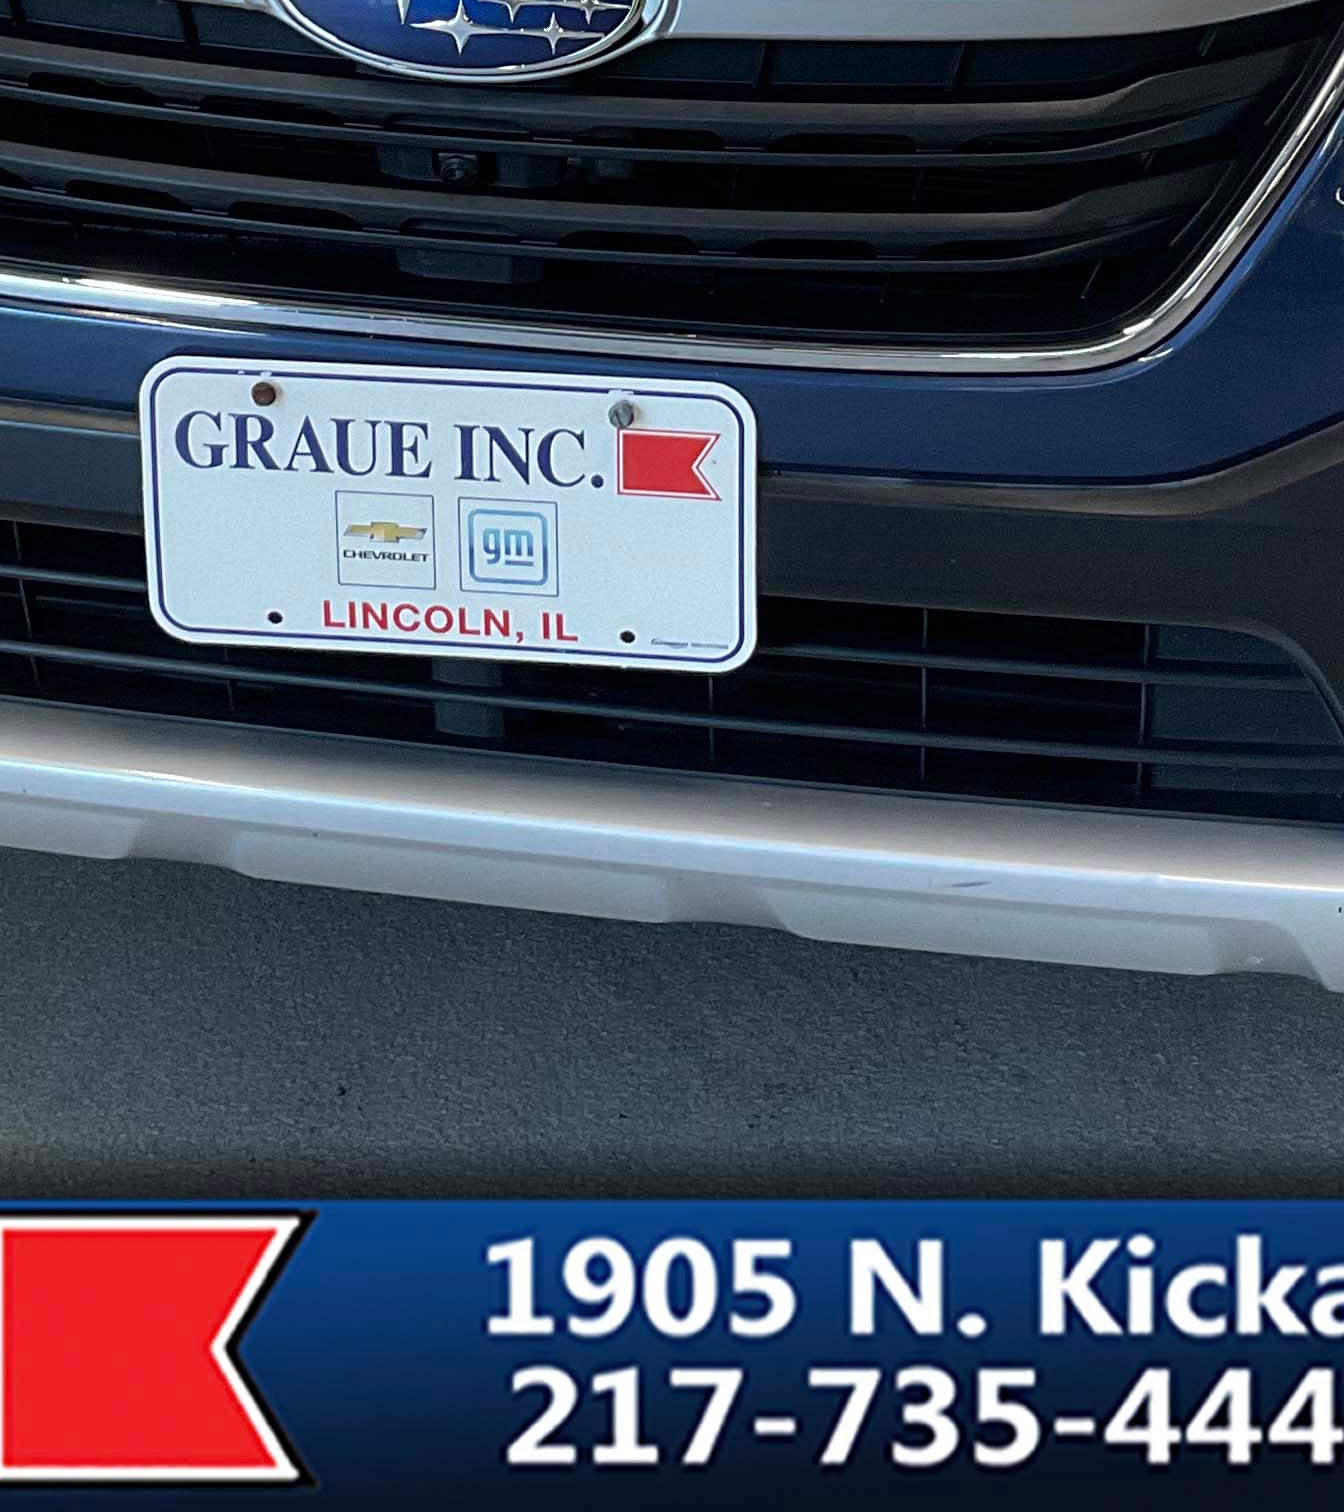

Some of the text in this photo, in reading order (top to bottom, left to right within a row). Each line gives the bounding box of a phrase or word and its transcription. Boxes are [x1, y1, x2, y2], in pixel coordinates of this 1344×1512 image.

[174, 409, 605, 489] GRAUE INC.
[342, 548, 430, 563] CHEVROLET
[482, 527, 534, 566] gm
[322, 599, 579, 644] LINCOLN, IL
